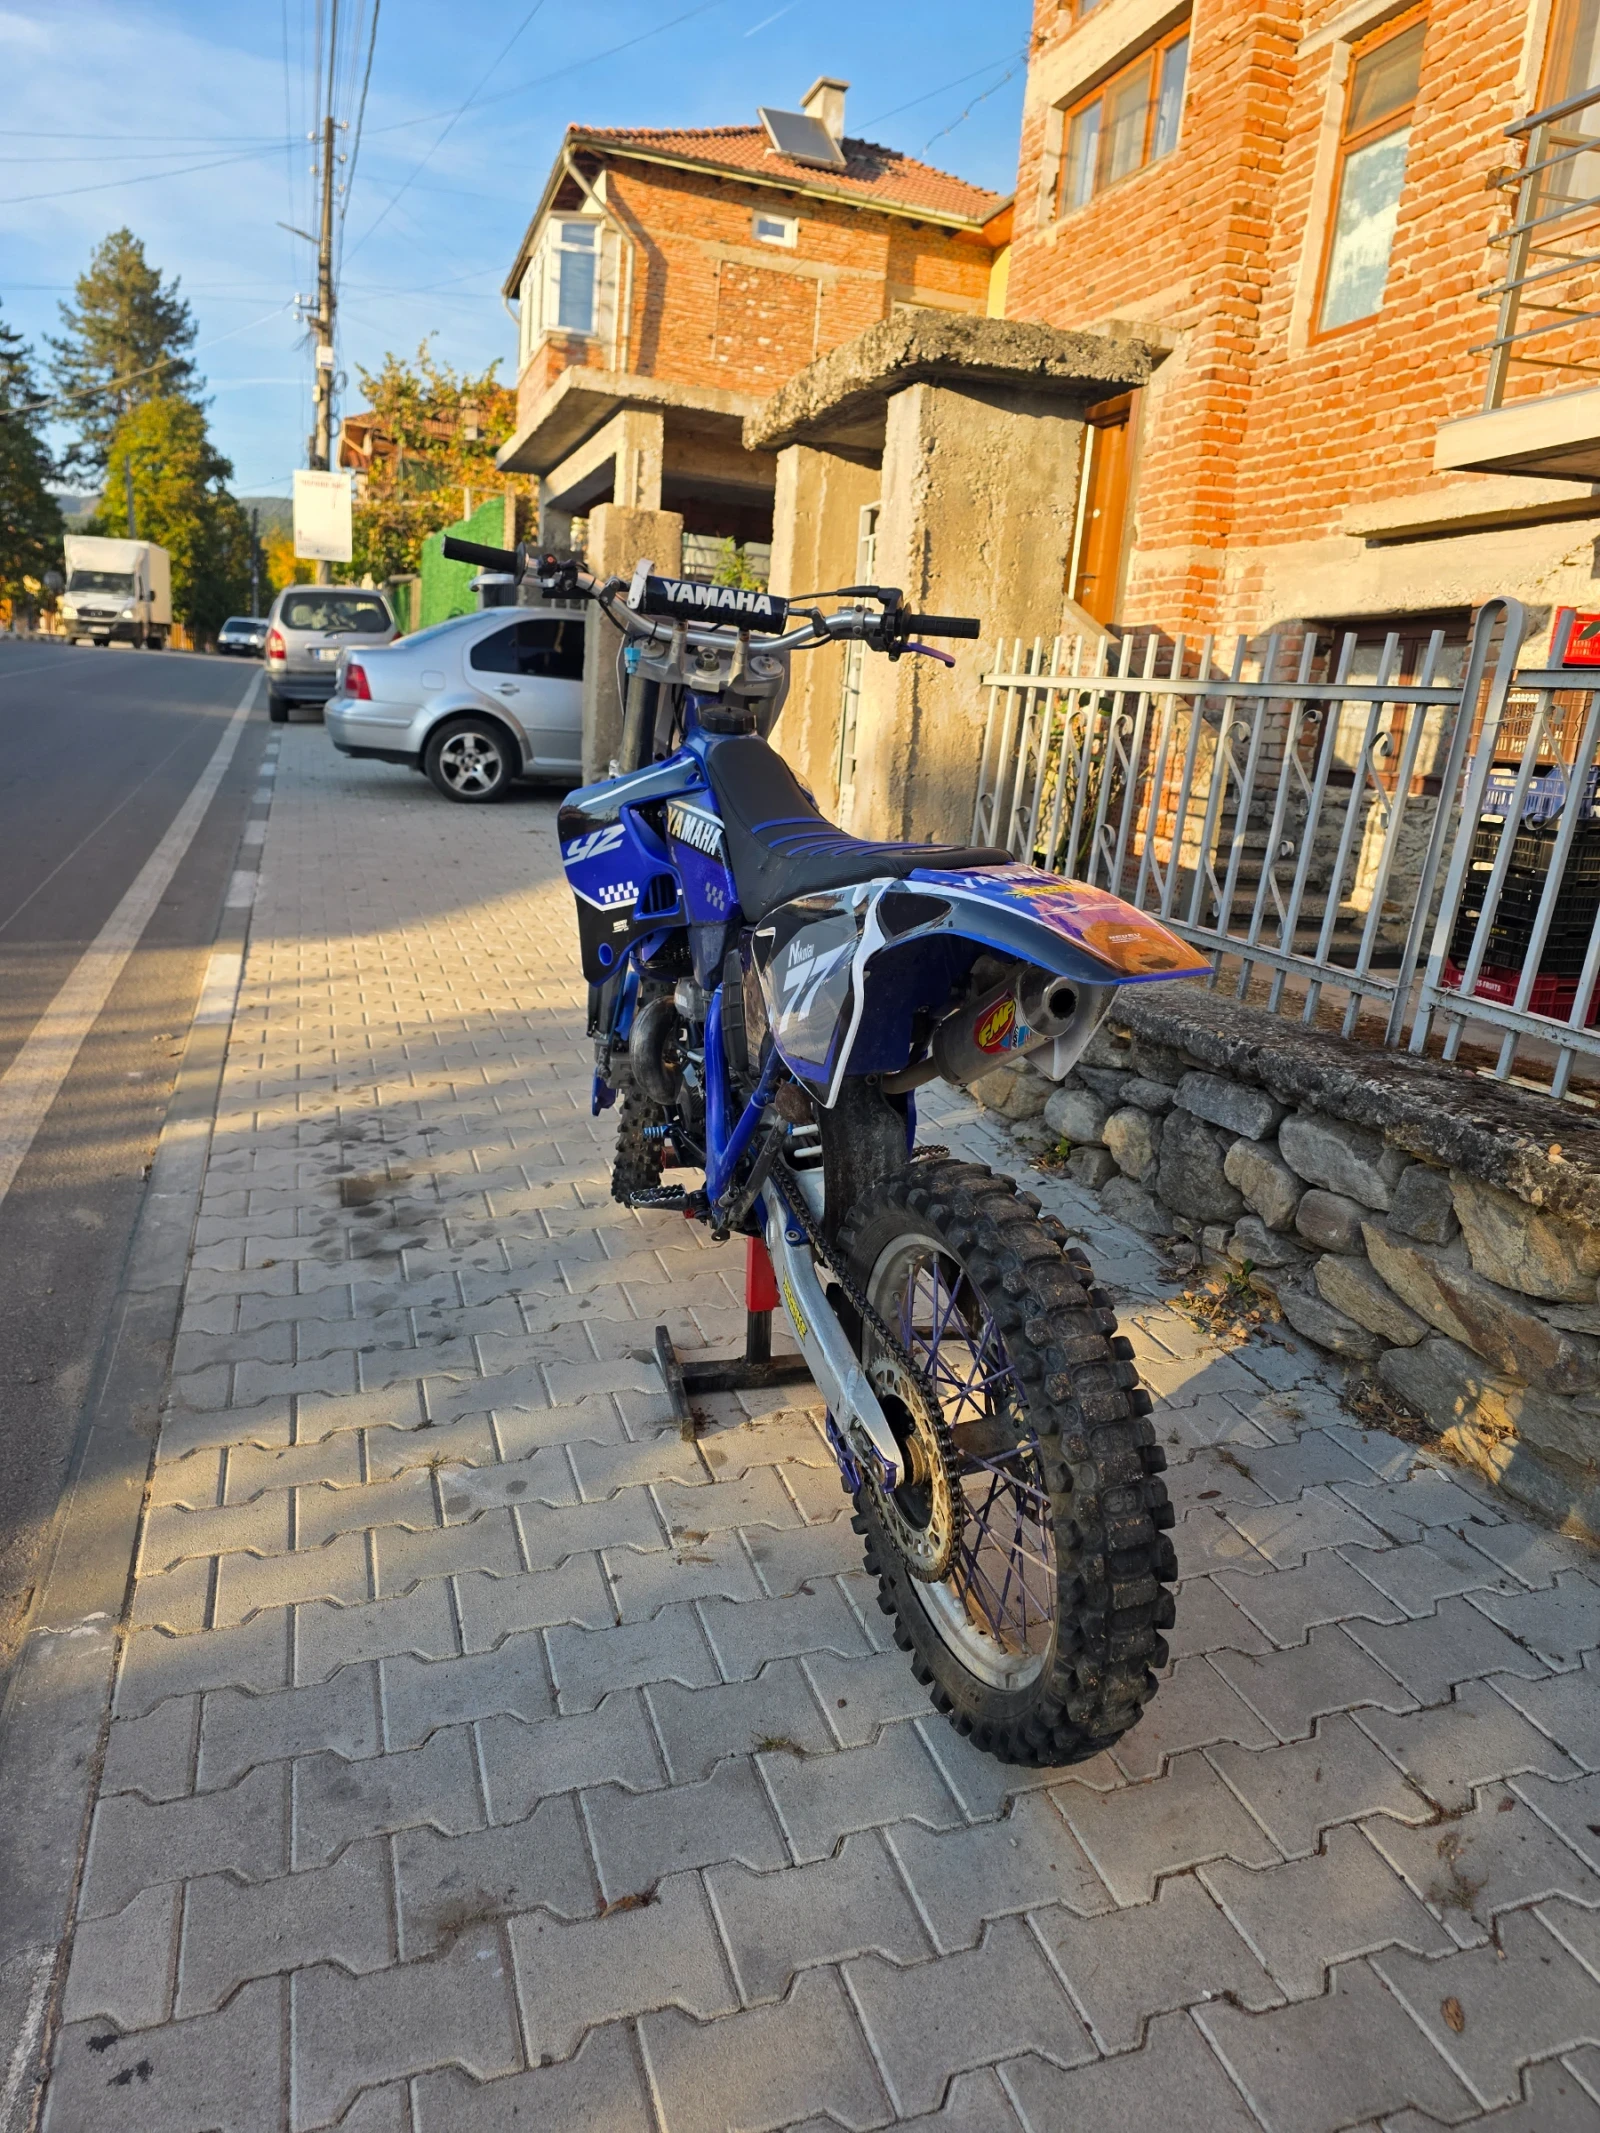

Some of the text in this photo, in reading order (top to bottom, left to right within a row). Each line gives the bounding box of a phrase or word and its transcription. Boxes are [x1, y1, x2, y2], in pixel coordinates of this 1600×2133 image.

[662, 580, 773, 616] YAMAHA
[563, 823, 627, 868] YZ
[667, 806, 724, 857] YAMAHA
[778, 941, 852, 1035] 77
[979, 1000, 1014, 1048] FMF
